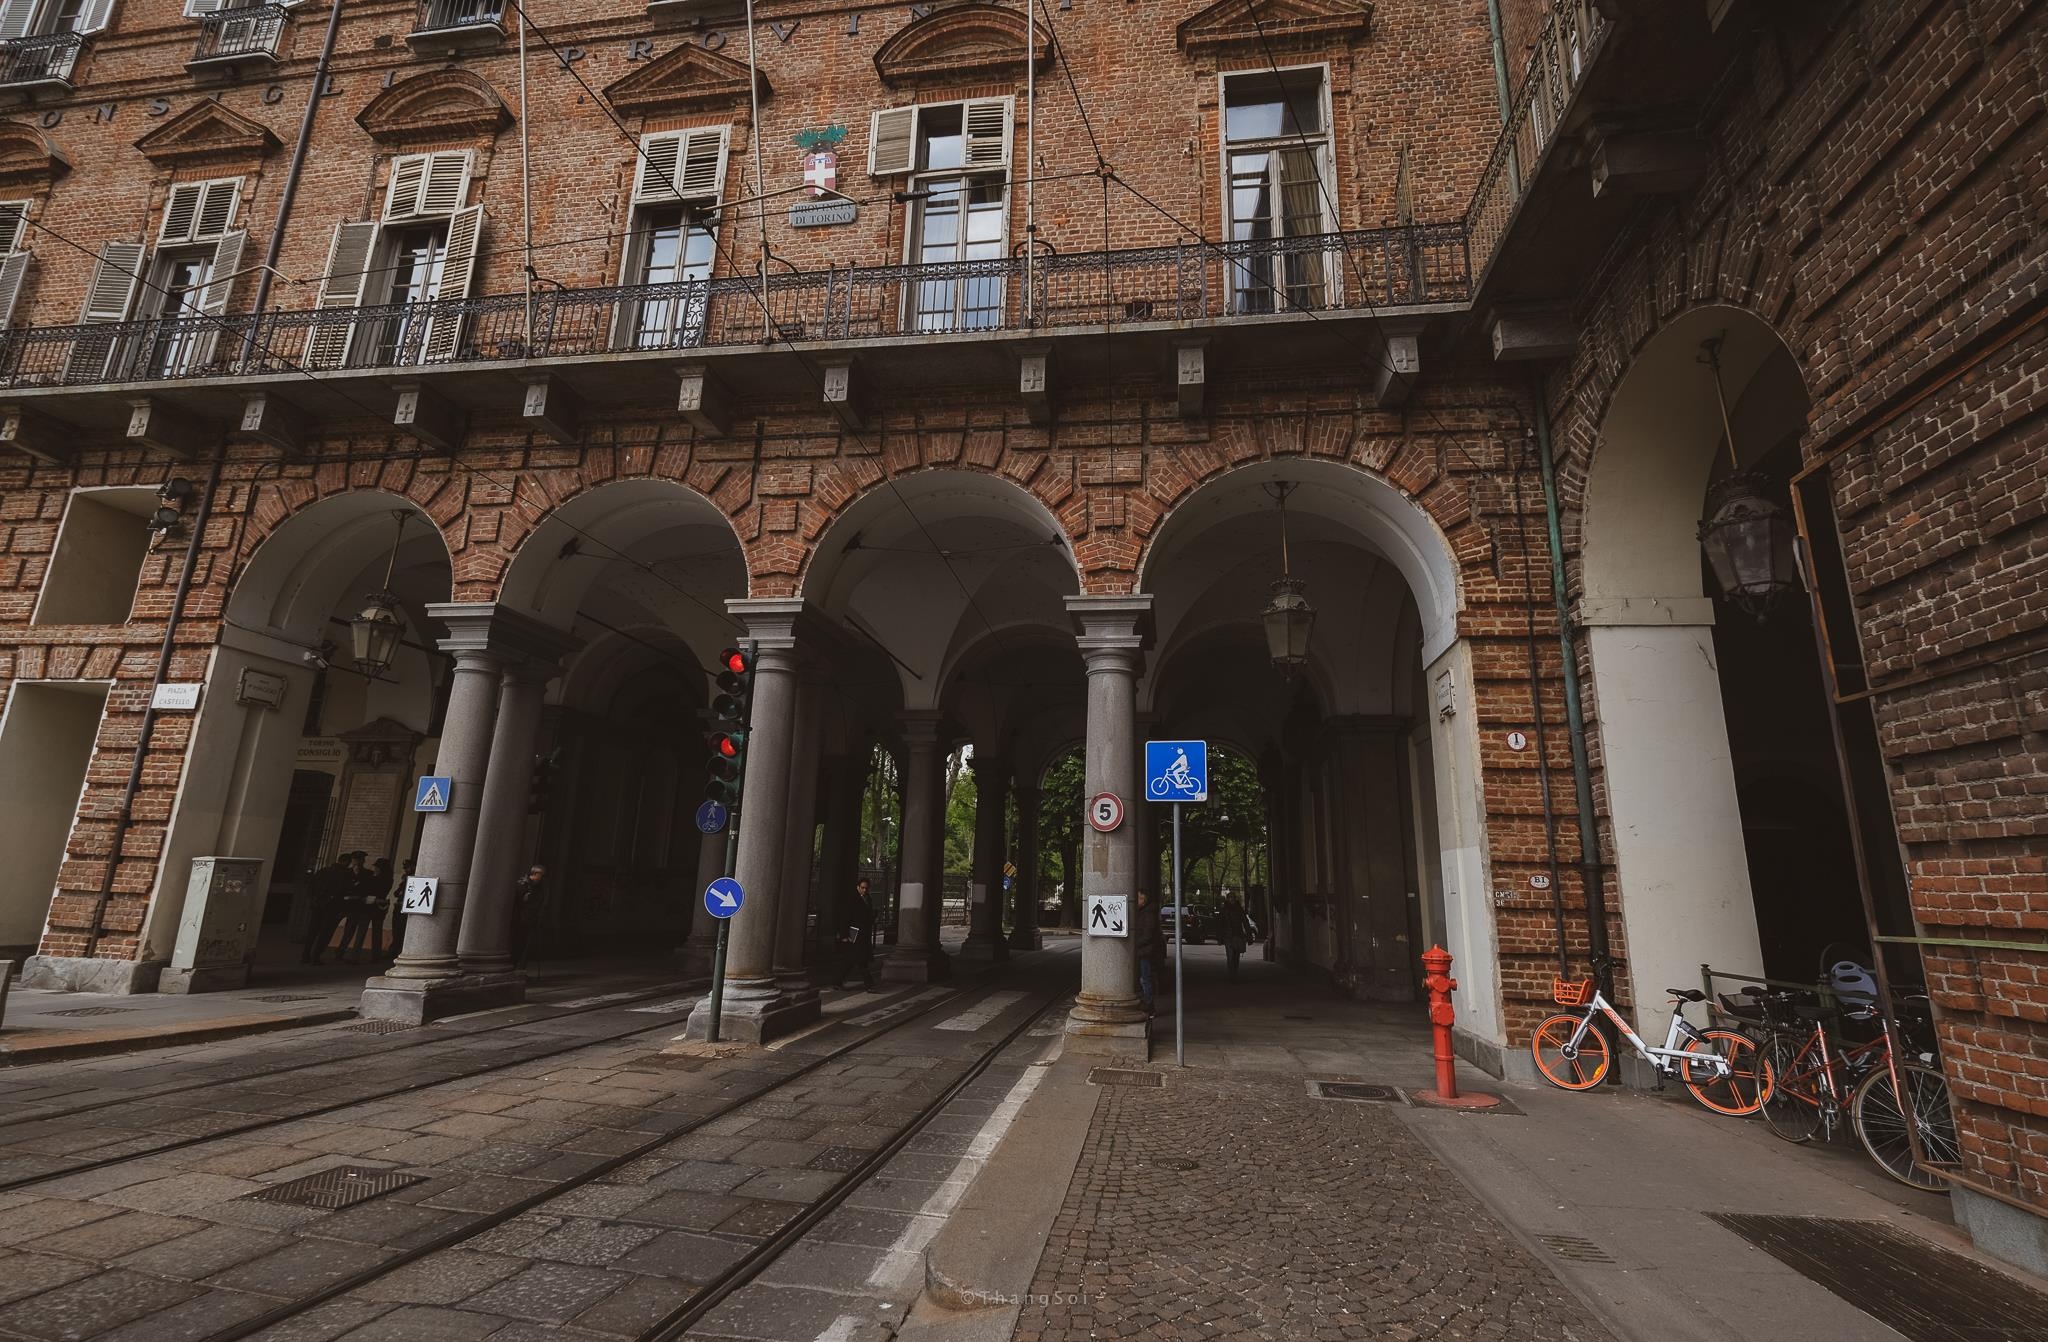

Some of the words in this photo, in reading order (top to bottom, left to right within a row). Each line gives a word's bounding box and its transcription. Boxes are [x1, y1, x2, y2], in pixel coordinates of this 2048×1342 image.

[795, 201, 852, 214] PROVINCIA
[795, 216, 806, 225] DI
[810, 212, 851, 224] TORINO
[167, 687, 187, 695] PIAZZA
[297, 748, 341, 757] CONSIGLIO
[1099, 803, 1112, 821] 5
